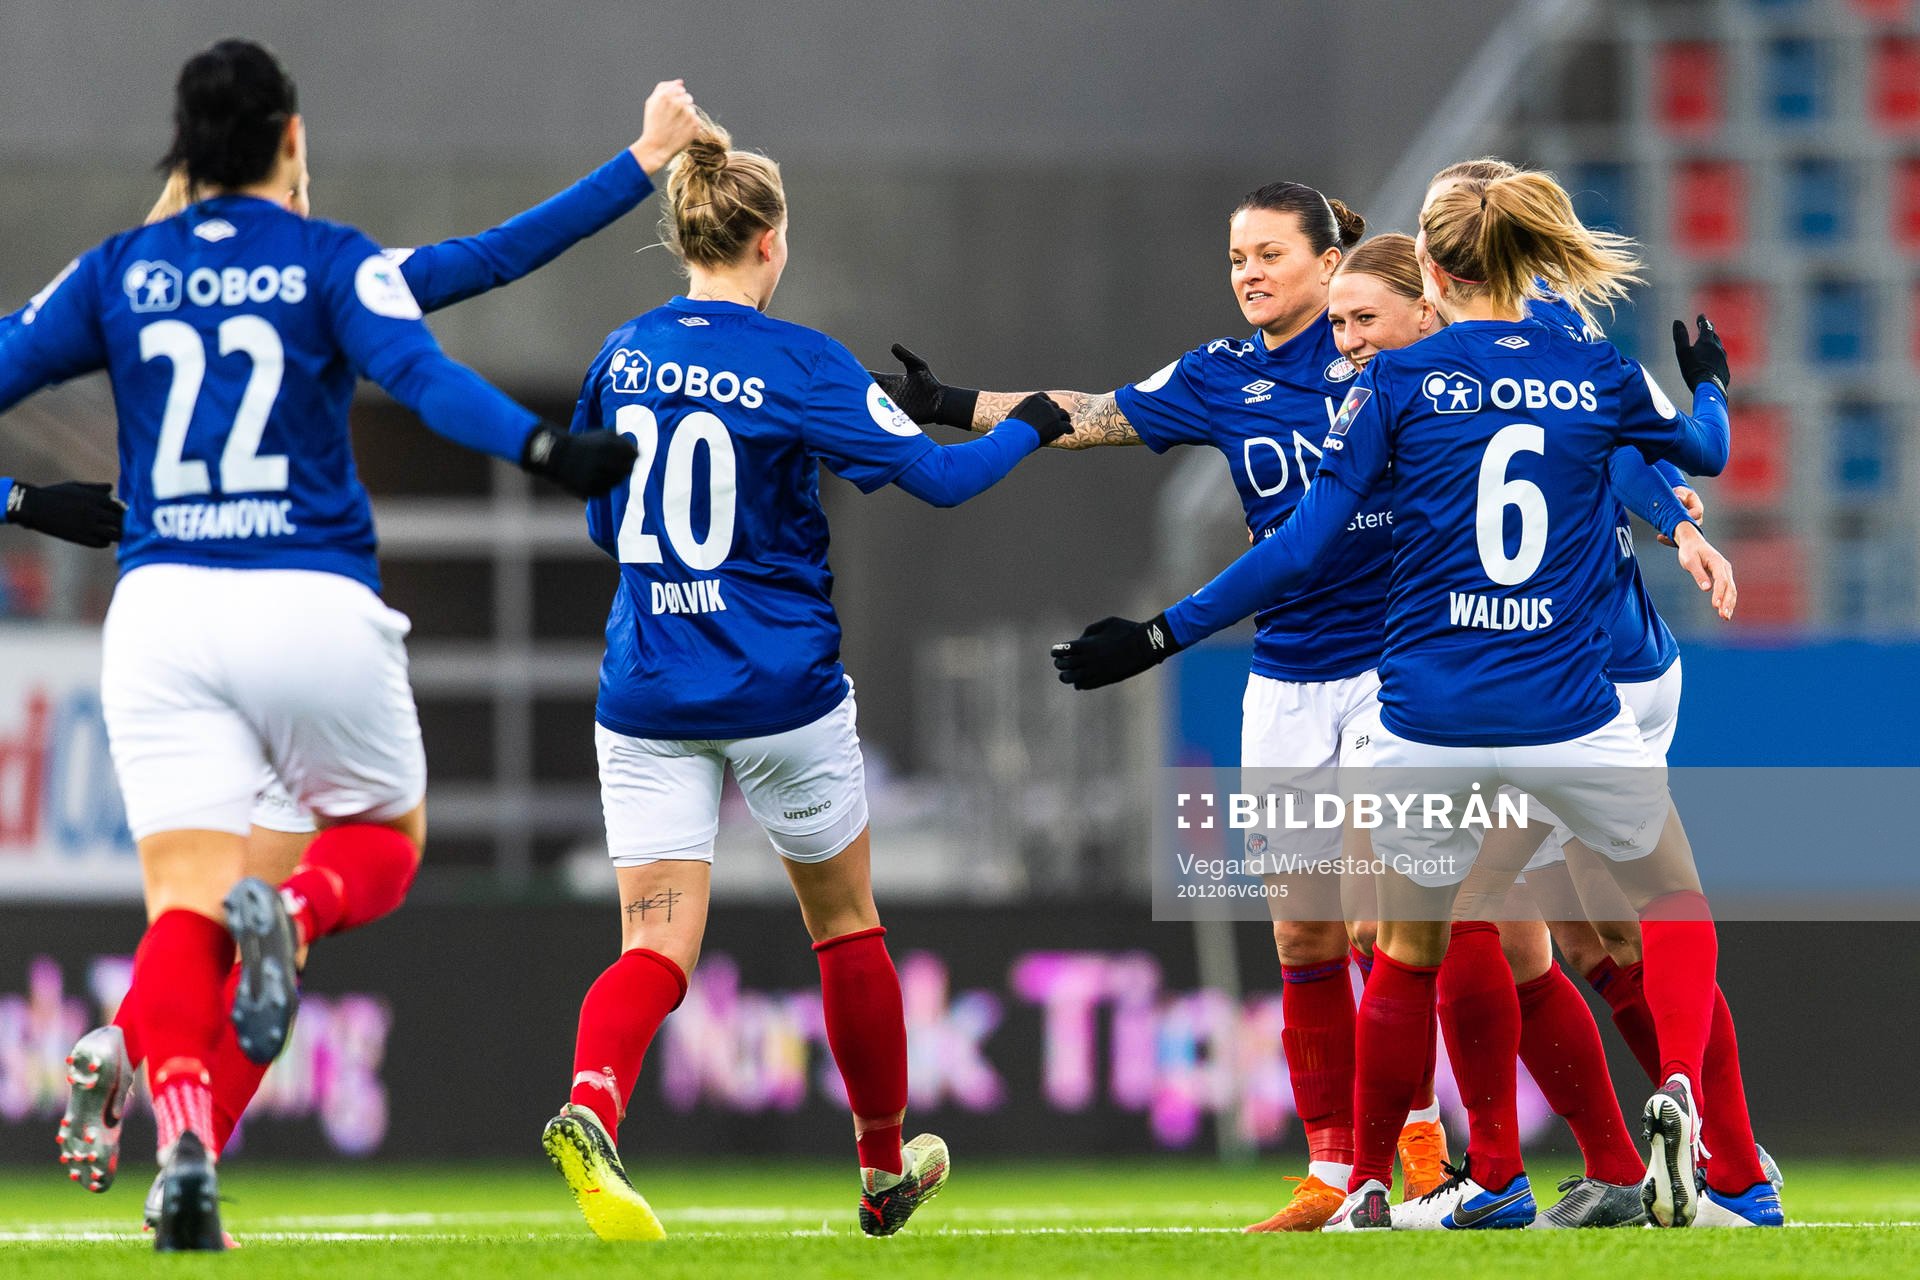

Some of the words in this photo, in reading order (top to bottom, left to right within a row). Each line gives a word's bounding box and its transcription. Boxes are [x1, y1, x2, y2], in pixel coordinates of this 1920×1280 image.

[187, 264, 306, 306] OBOS
[656, 361, 765, 409] OBOS
[1244, 393, 1272, 404] umbro
[1490, 377, 1598, 412] OBOS
[139, 315, 289, 499] 22
[616, 404, 737, 571] 20
[1475, 423, 1549, 587] 6
[153, 498, 298, 541] STEFANOVIC
[651, 579, 727, 615] DØLVIK
[1449, 592, 1554, 631] WALDUS
[783, 800, 832, 820] umbro
